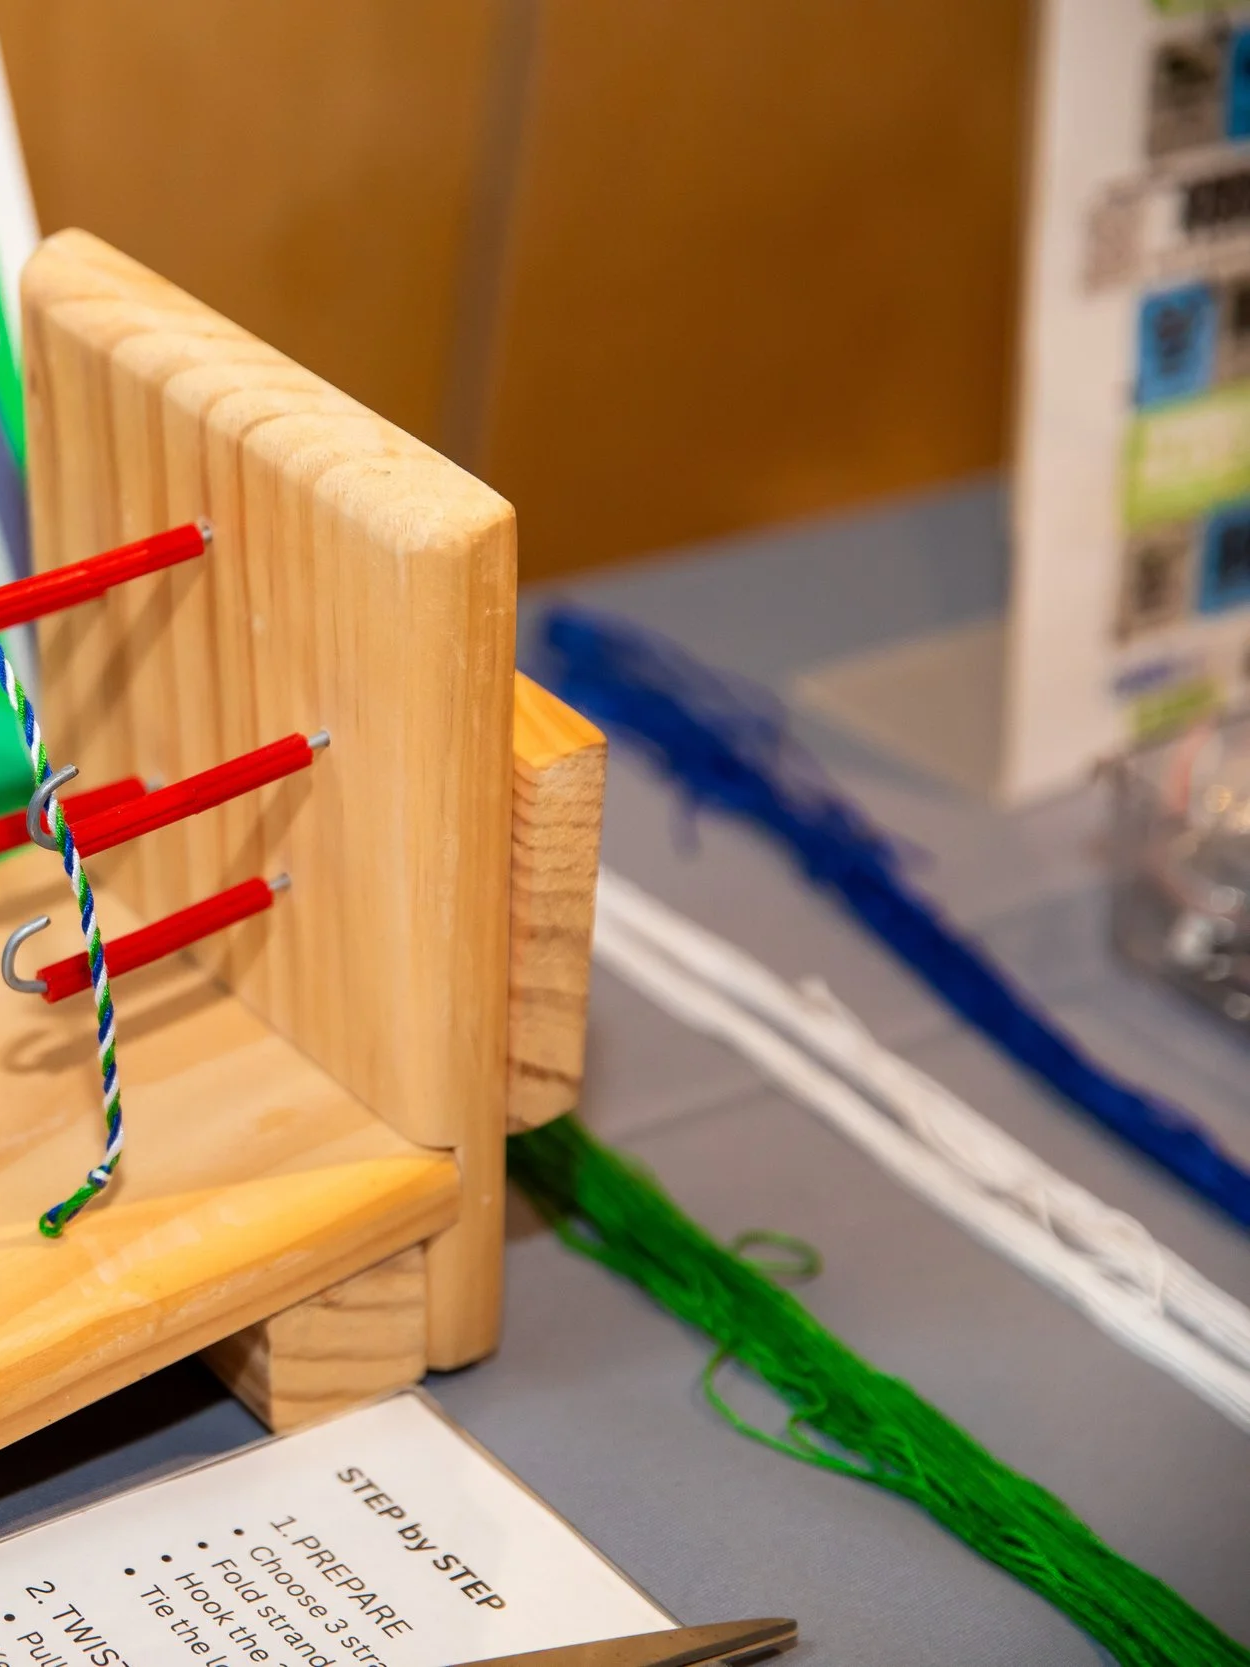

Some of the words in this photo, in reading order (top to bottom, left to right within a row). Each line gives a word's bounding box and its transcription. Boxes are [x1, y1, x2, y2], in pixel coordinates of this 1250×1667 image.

[211, 1558, 268, 1603] Fold
[270, 1515, 297, 1538] 1.
[292, 1535, 413, 1638] PREPARE
[337, 1466, 406, 1520] STEP
[398, 1523, 437, 1551] by
[432, 1554, 506, 1610] STEP
[25, 1581, 55, 1604] 2.
[52, 1604, 130, 1667] TWIS
[140, 1584, 174, 1617] Tie
[170, 1618, 210, 1655] the
[175, 1572, 234, 1625] Hook
[228, 1625, 269, 1662] the
[250, 1546, 327, 1618] Choose
[325, 1618, 348, 1634] 3
